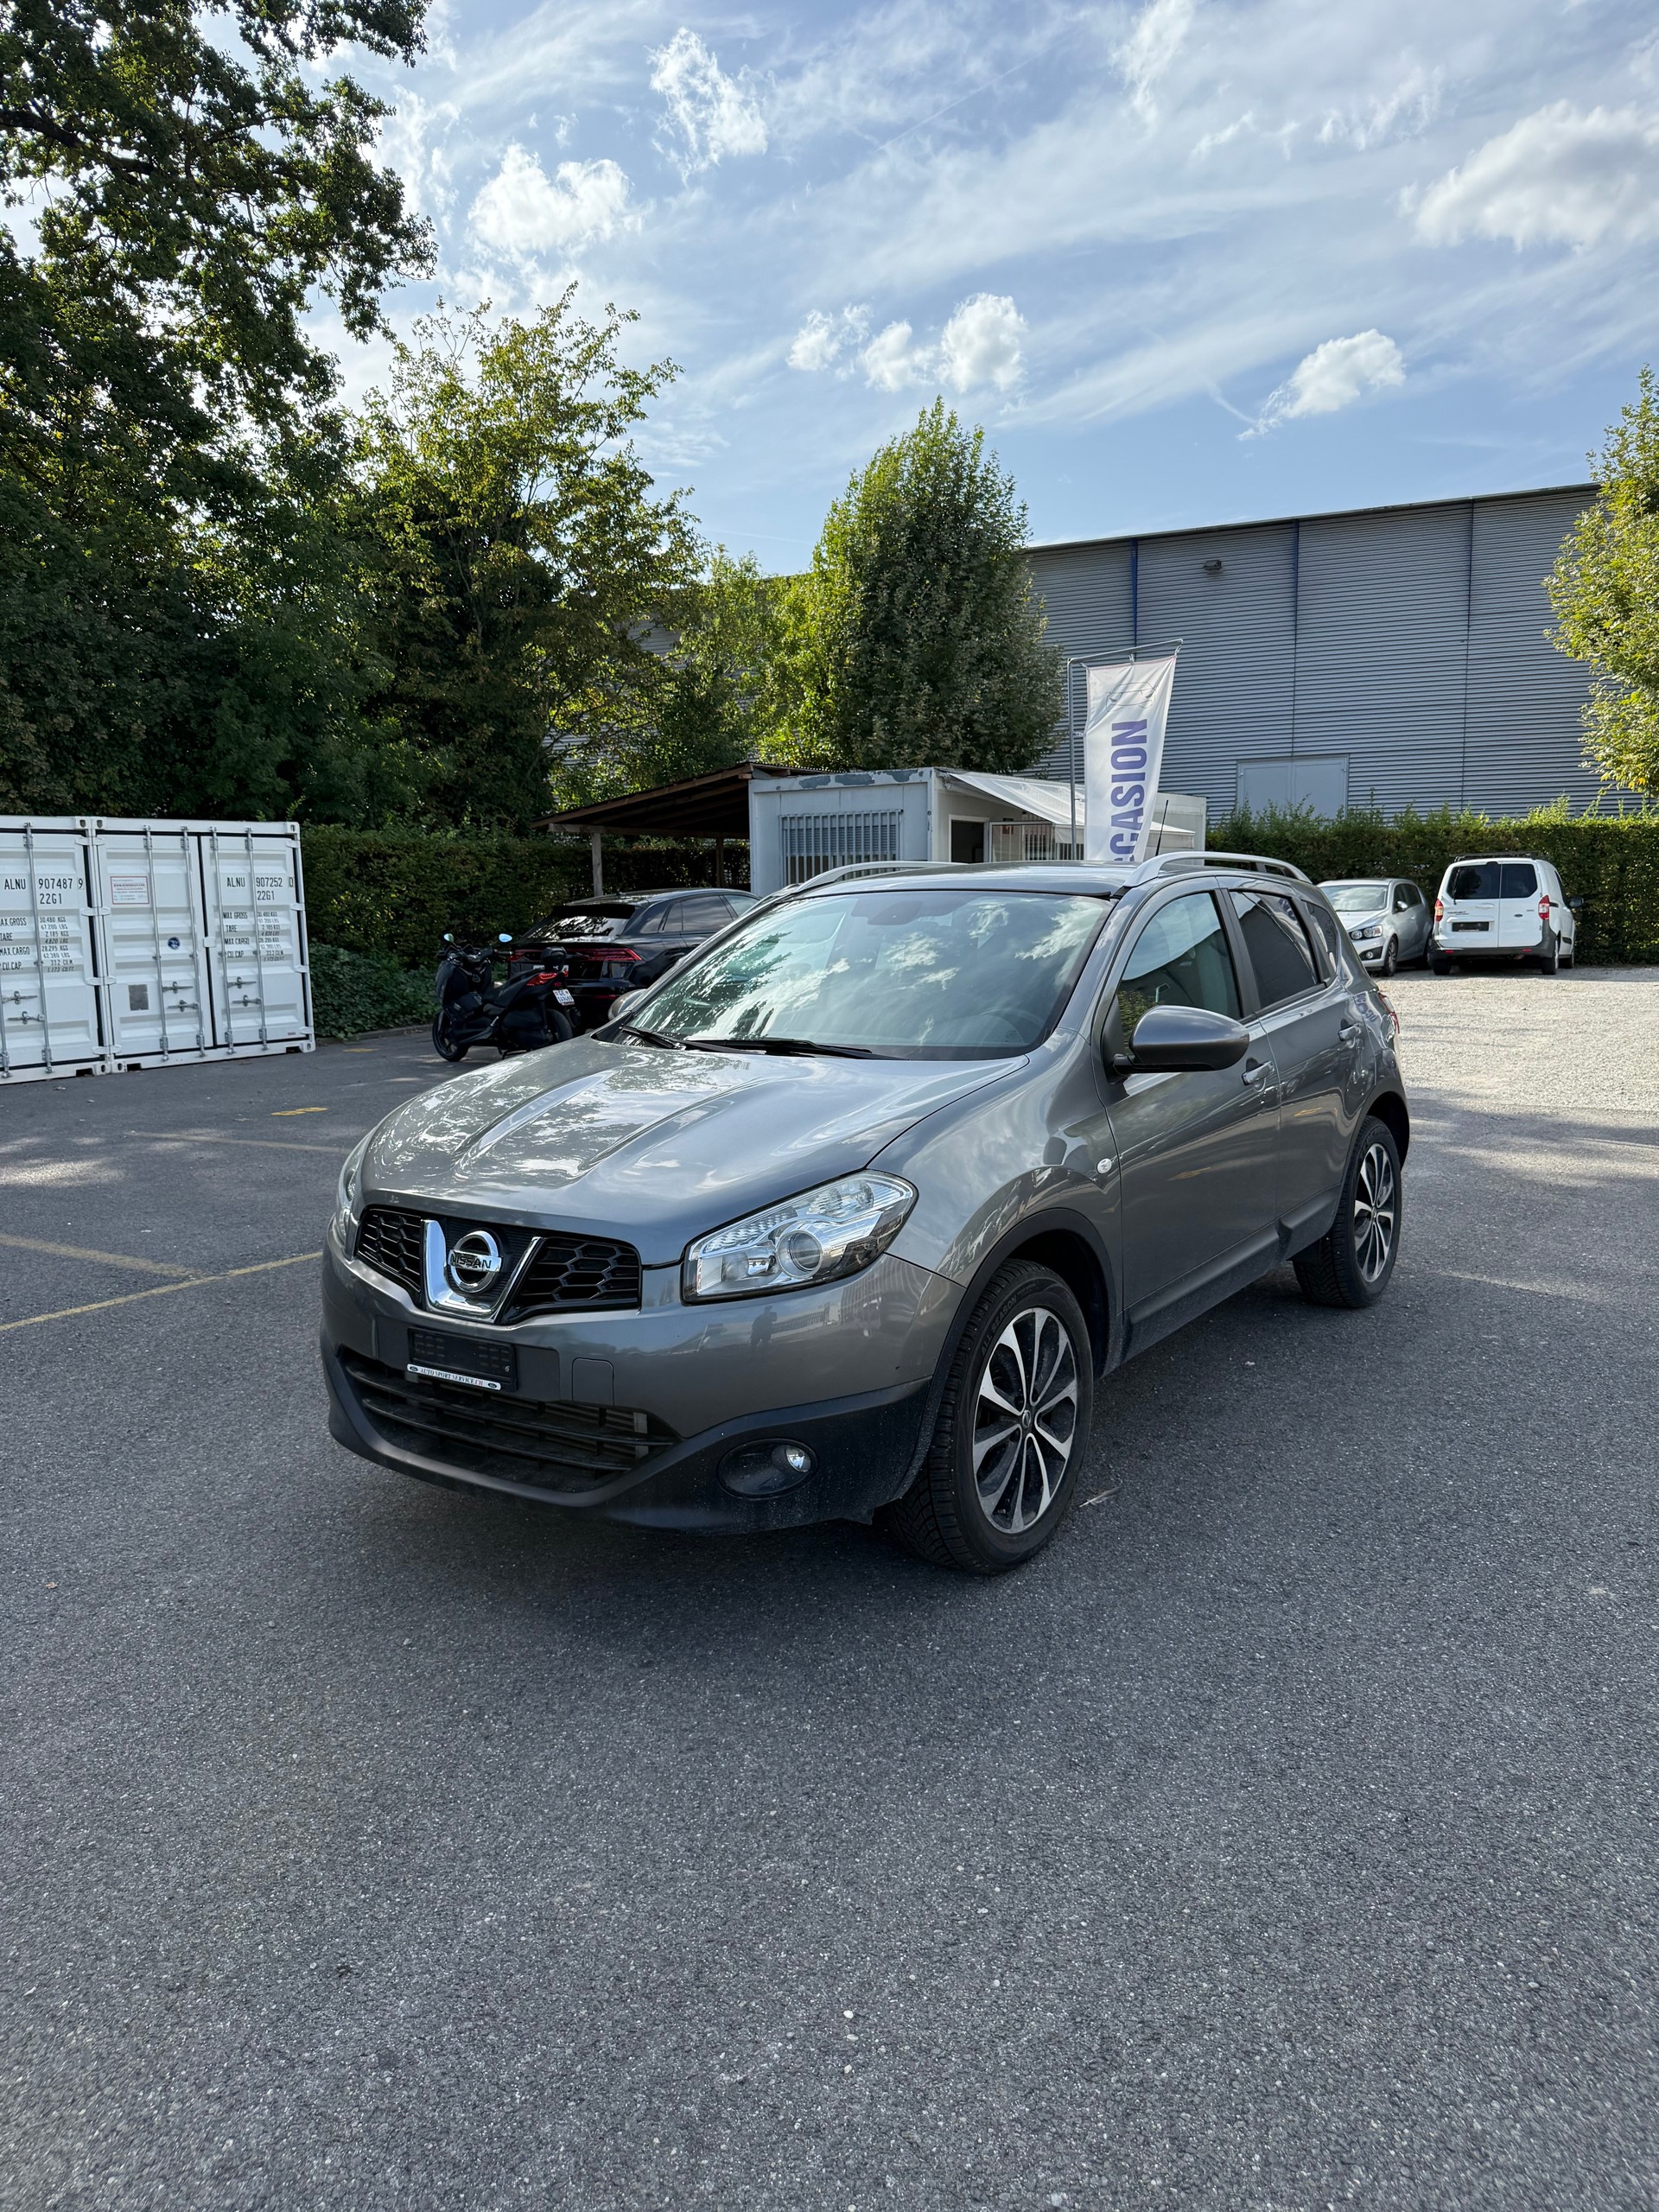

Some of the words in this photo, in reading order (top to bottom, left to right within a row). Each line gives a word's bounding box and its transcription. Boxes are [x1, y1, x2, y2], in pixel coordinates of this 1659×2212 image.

[1110, 719, 1147, 862] CASION
[4, 878, 26, 890] ALNU
[38, 878, 73, 889] 907487
[78, 878, 84, 889] 9
[226, 877, 245, 887] ALNU
[256, 877, 283, 887] 907252
[289, 877, 294, 887] 0
[40, 893, 62, 904] 22G1
[257, 890, 275, 900] 22G1
[450, 1253, 492, 1268] NISSAN
[435, 1370, 452, 1380] SPORT
